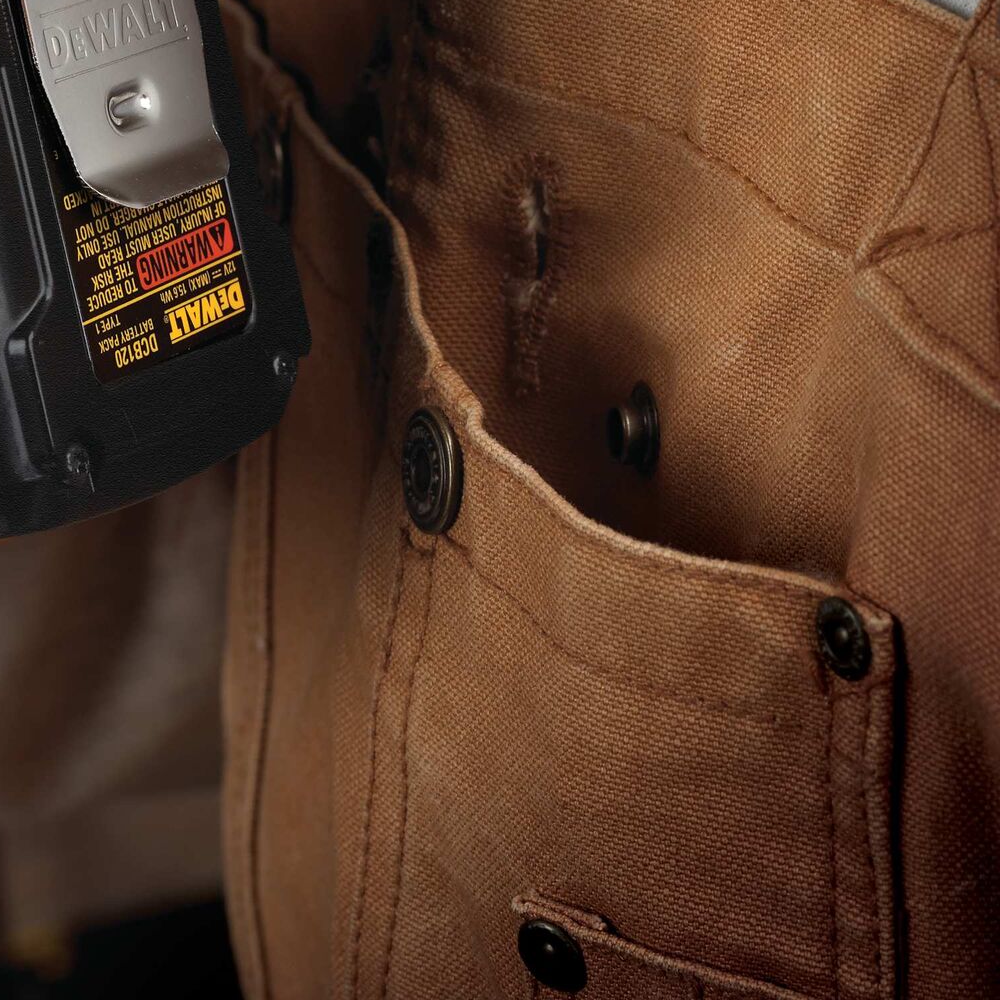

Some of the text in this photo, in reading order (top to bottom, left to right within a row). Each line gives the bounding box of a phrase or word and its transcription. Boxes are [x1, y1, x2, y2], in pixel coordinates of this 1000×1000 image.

[162, 184, 223, 222] INSTRUCTION
[214, 201, 226, 219] OF
[75, 224, 95, 244] NOT
[95, 218, 110, 234] DO
[119, 212, 163, 239] MANUAL.
[153, 222, 177, 248] USER
[76, 238, 101, 262] ONLY
[101, 229, 121, 251] USE
[126, 236, 151, 259] MUST
[98, 247, 124, 270] READ
[139, 233, 213, 286] WARNING
[91, 262, 134, 291] THE RISK
[160, 260, 237, 304] 12V (MAX) 15.6 Wh
[86, 277, 138, 313] TO REDUCE
[95, 314, 121, 334] TYPE 1
[98, 318, 154, 354] BATTERY PACK
[115, 333, 159, 369] DCB120
